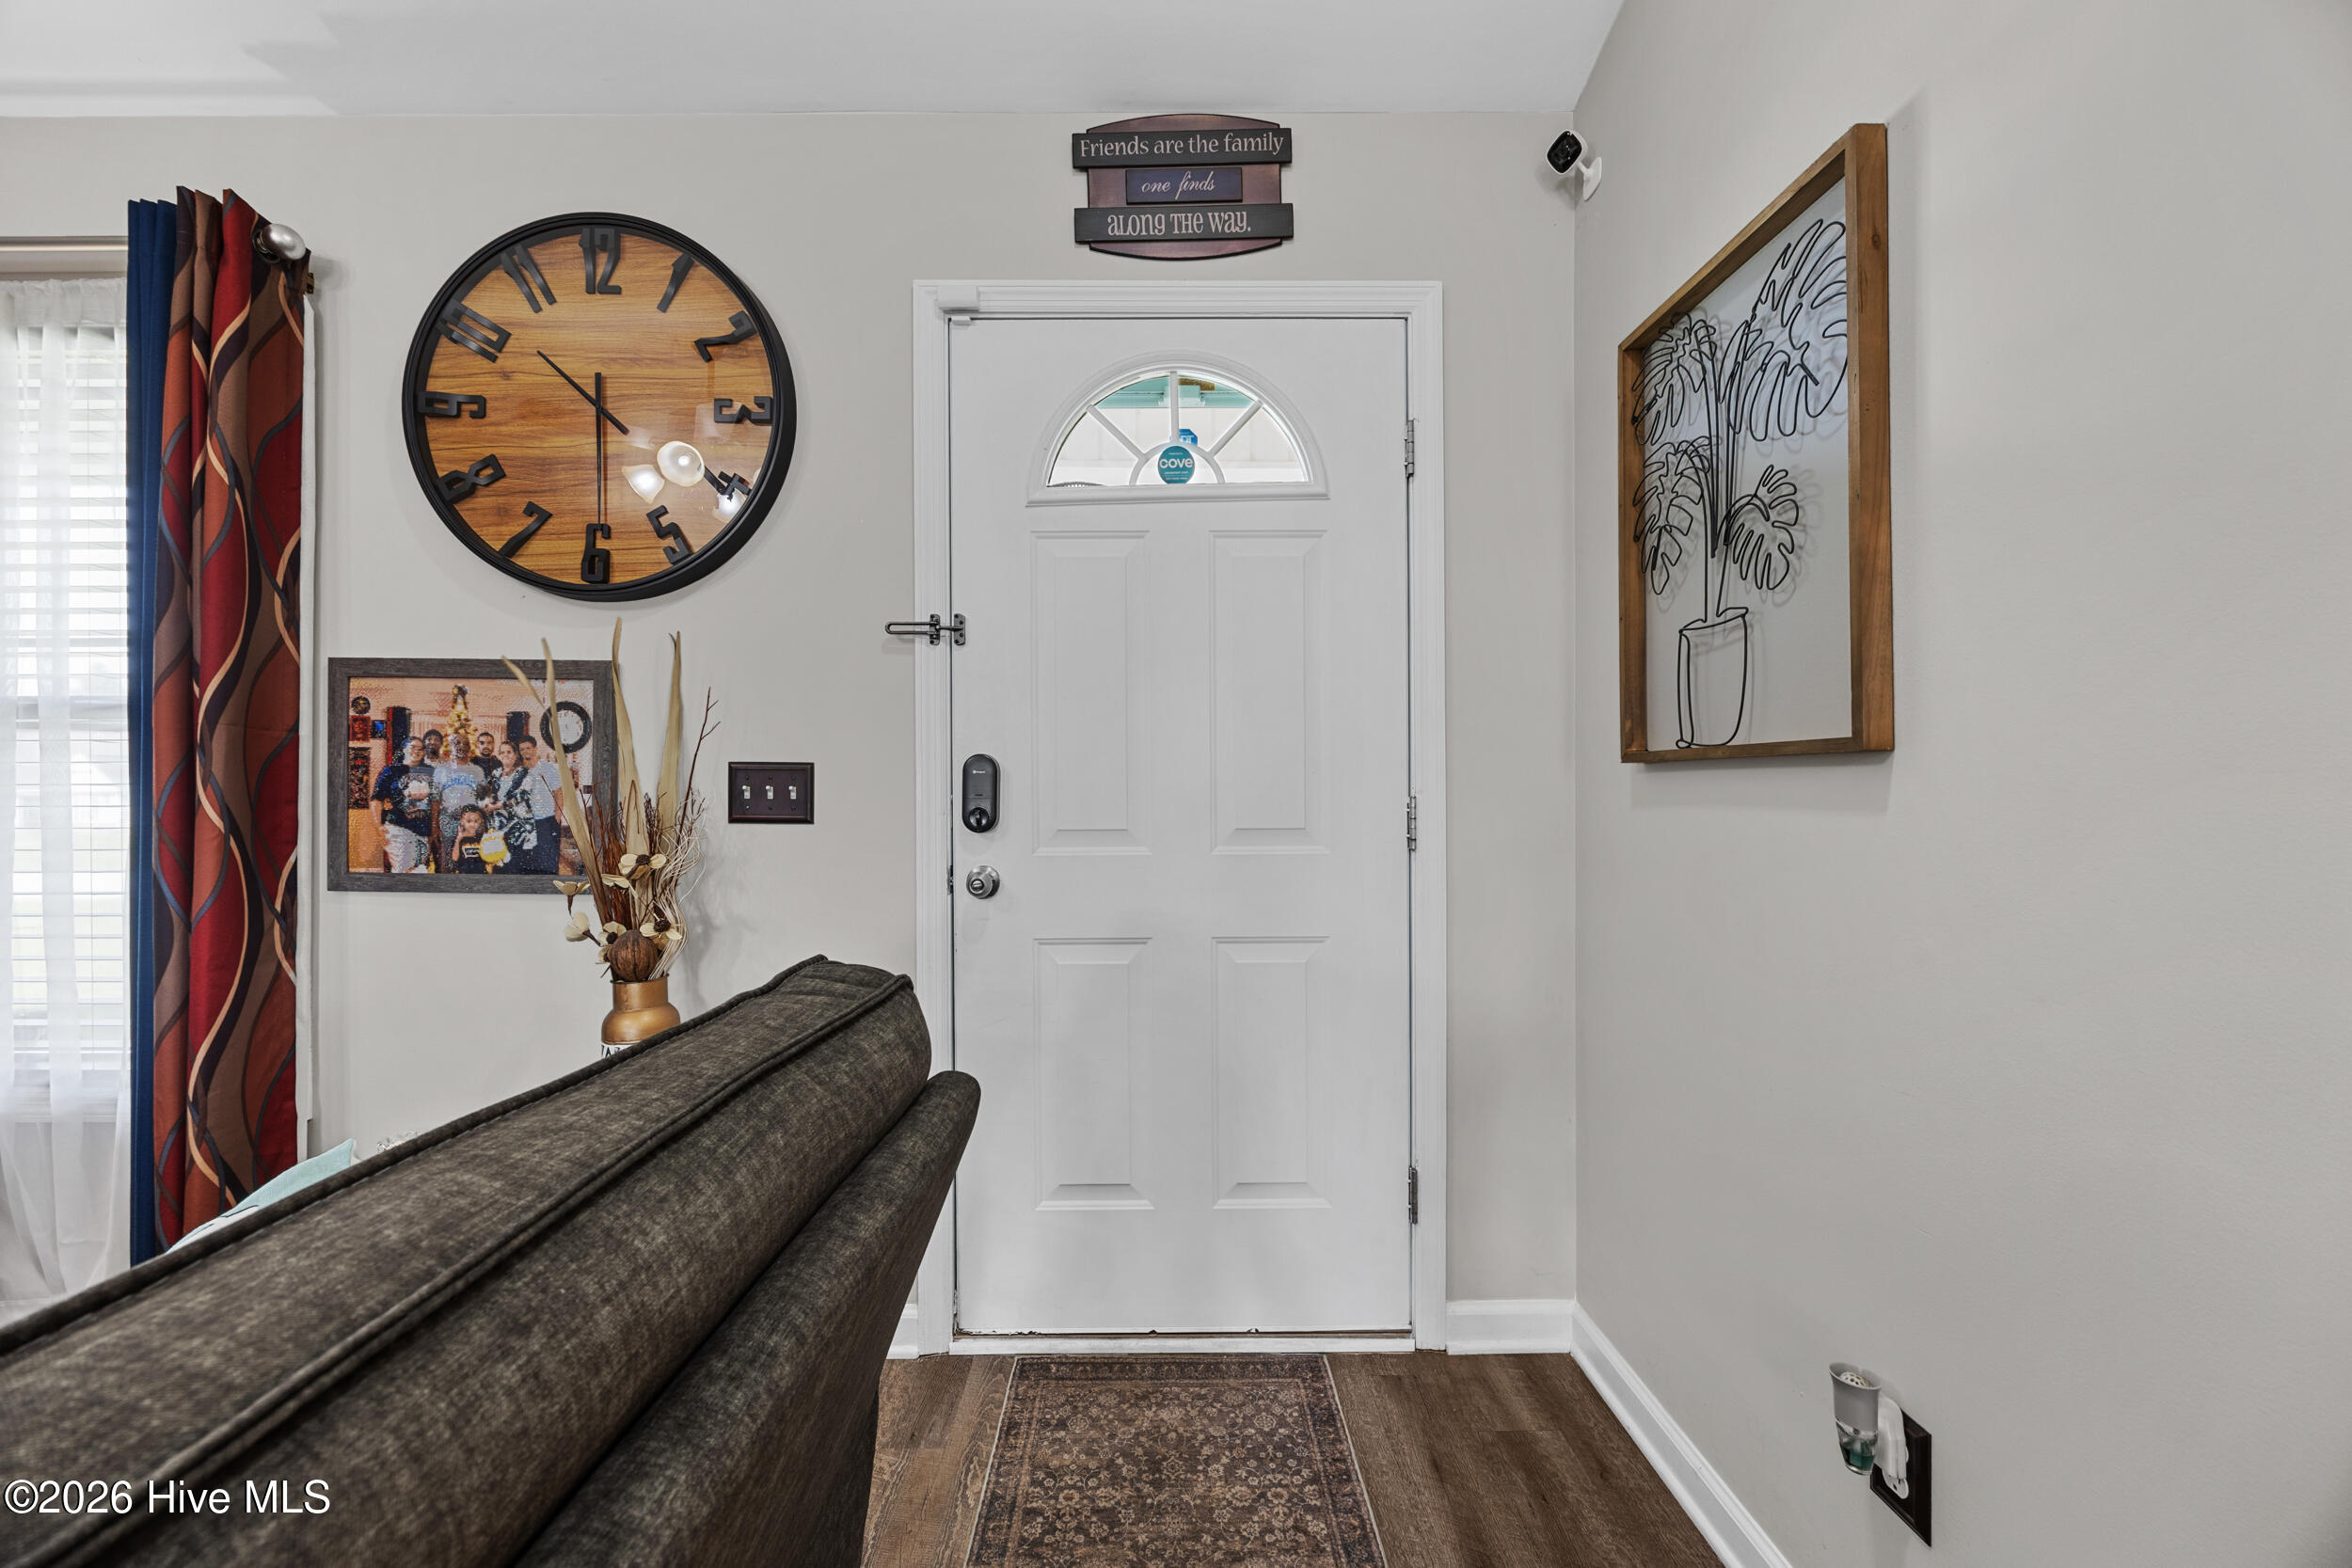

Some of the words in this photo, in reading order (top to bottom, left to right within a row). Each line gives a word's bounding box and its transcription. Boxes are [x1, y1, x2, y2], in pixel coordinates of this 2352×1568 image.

[1080, 135, 1150, 158] Friends
[1153, 140, 1184, 155] are
[1187, 136, 1220, 154] the
[1223, 132, 1284, 156] family
[1141, 179, 1171, 194] one
[1174, 170, 1216, 200] finds
[499, 243, 557, 314] 11
[578, 227, 623, 295] 12
[656, 251, 695, 314] 1
[436, 297, 513, 364] 10
[693, 309, 756, 363] 2
[416, 389, 486, 420] 9
[712, 395, 773, 425] 3
[436, 453, 507, 504] 8
[1159, 457, 1194, 468] cove
[497, 500, 553, 559] 7
[580, 522, 612, 585] 6
[645, 504, 693, 565] 5
